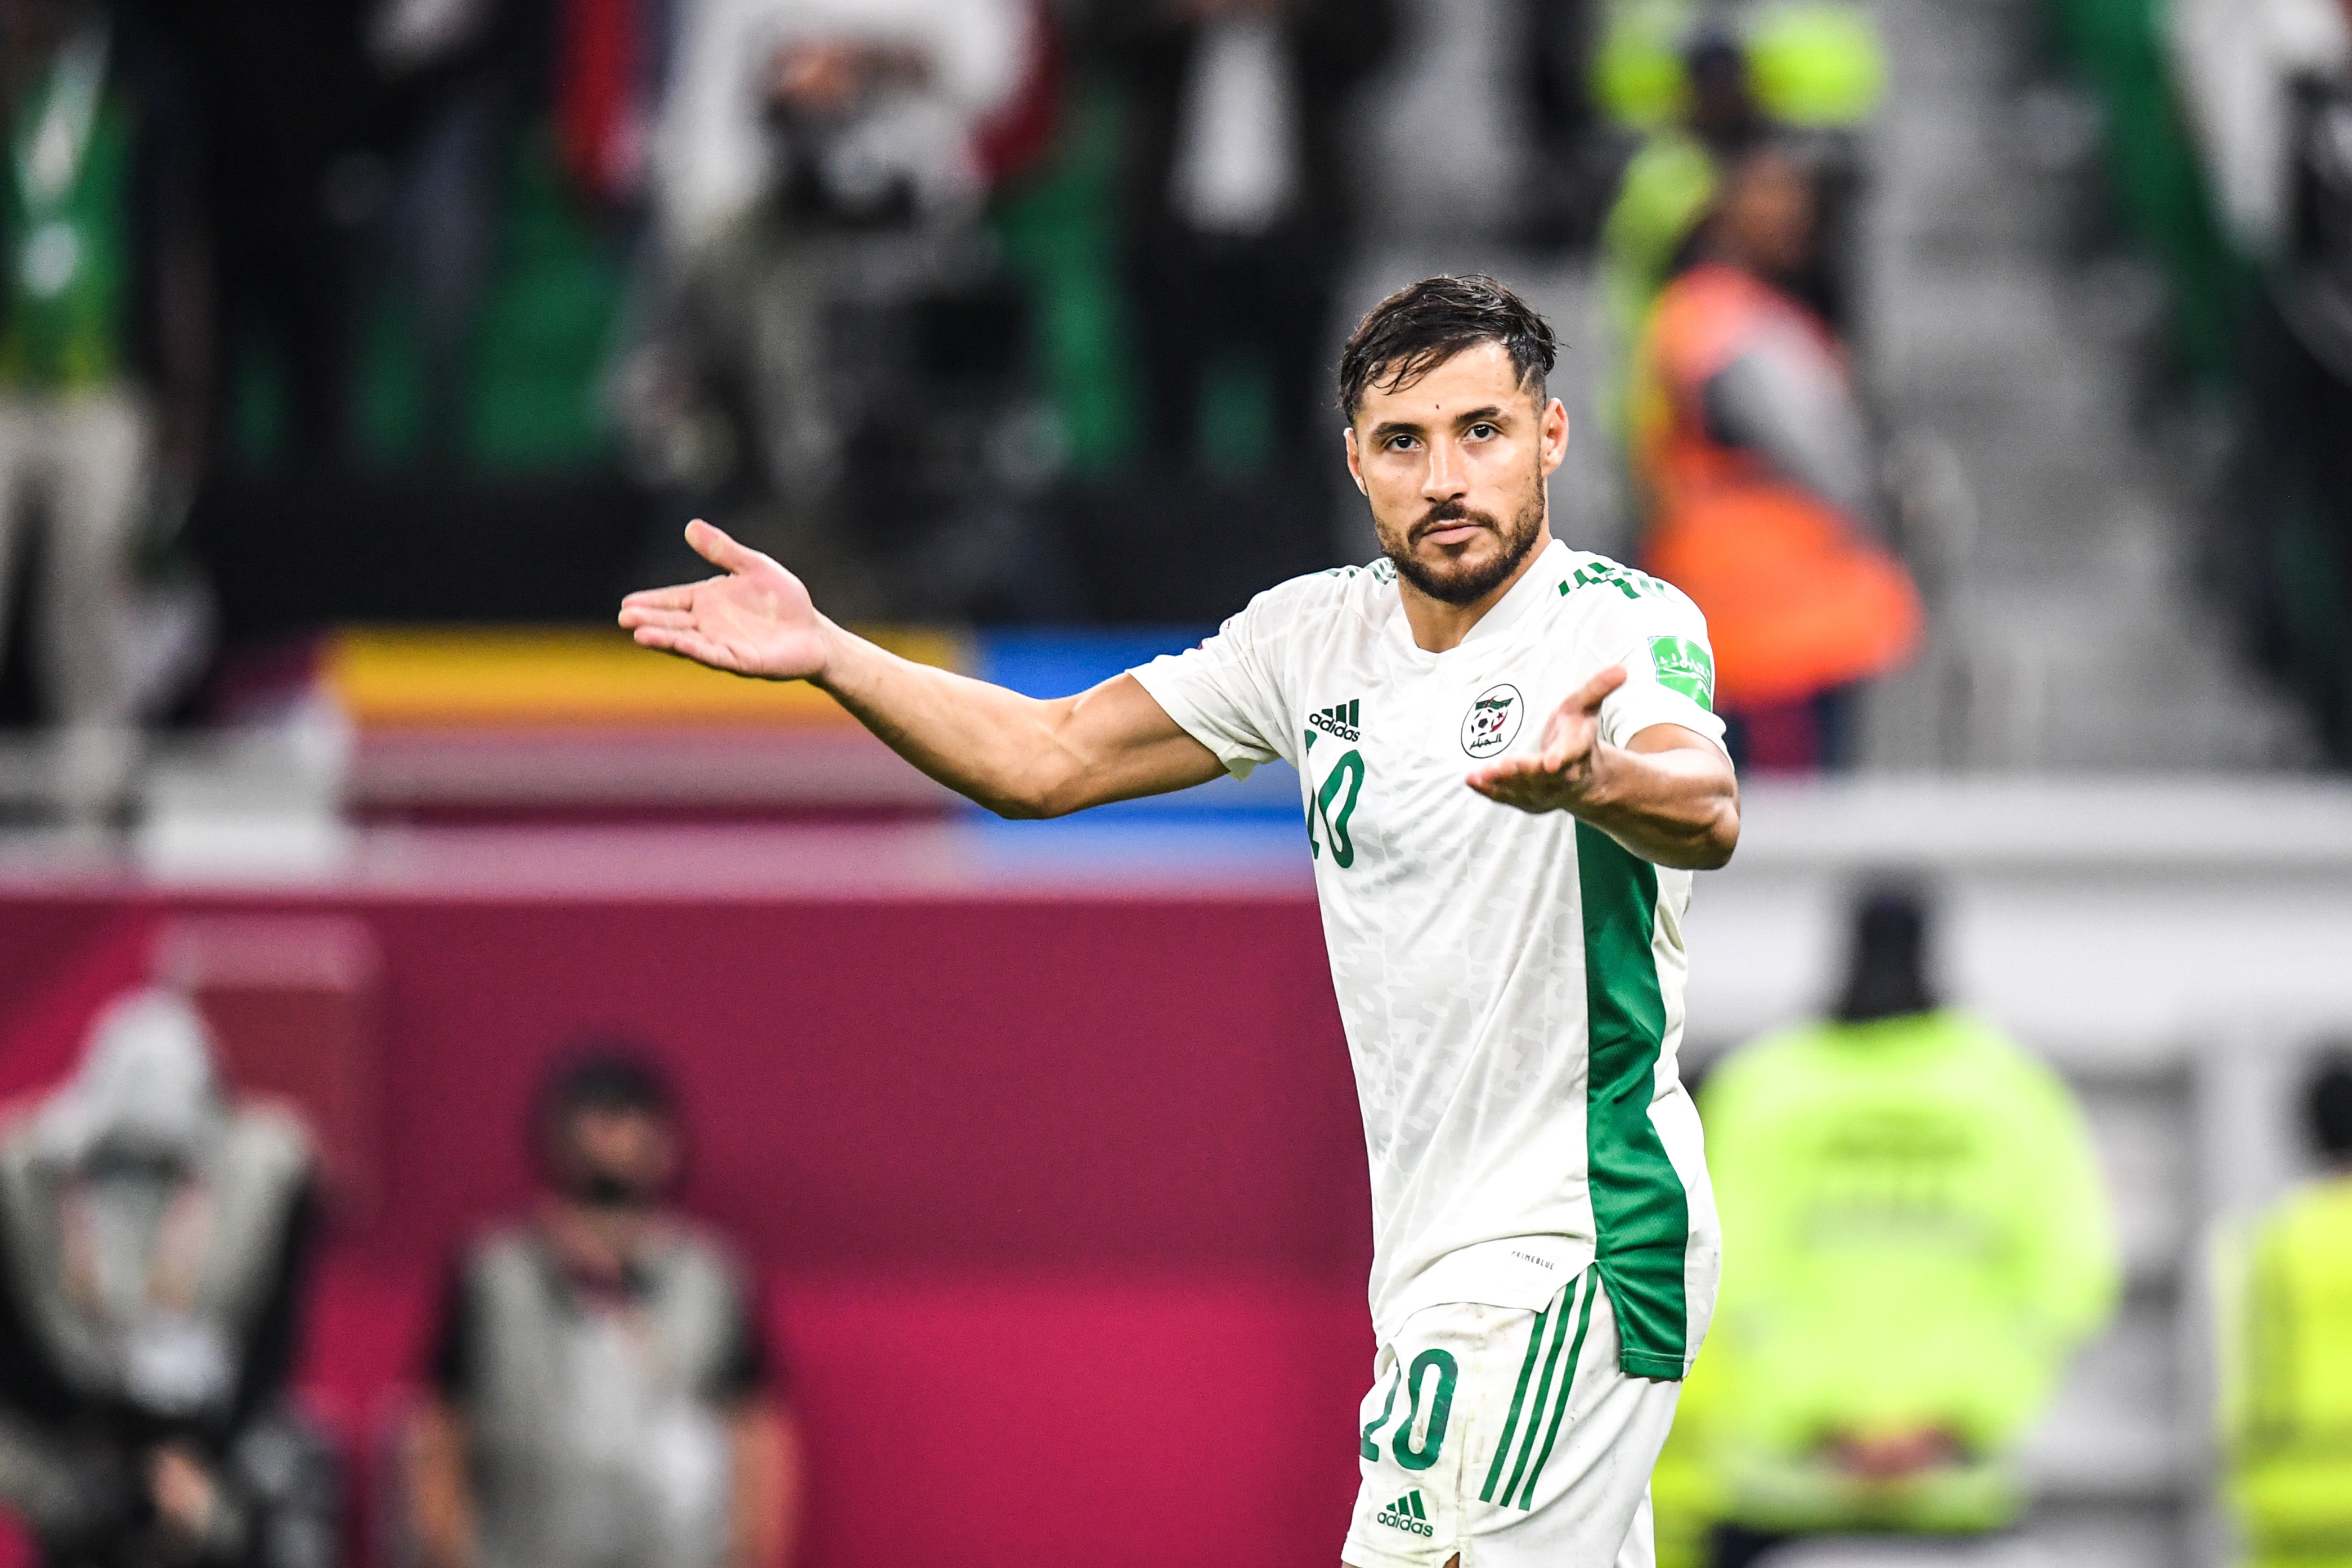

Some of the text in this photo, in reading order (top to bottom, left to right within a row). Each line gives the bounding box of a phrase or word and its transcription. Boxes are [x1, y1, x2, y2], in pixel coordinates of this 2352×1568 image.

[1309, 713, 1361, 742] adidas
[1511, 1250, 1555, 1270] PRIMEBLUE
[1377, 1511, 1434, 1538] adidas
